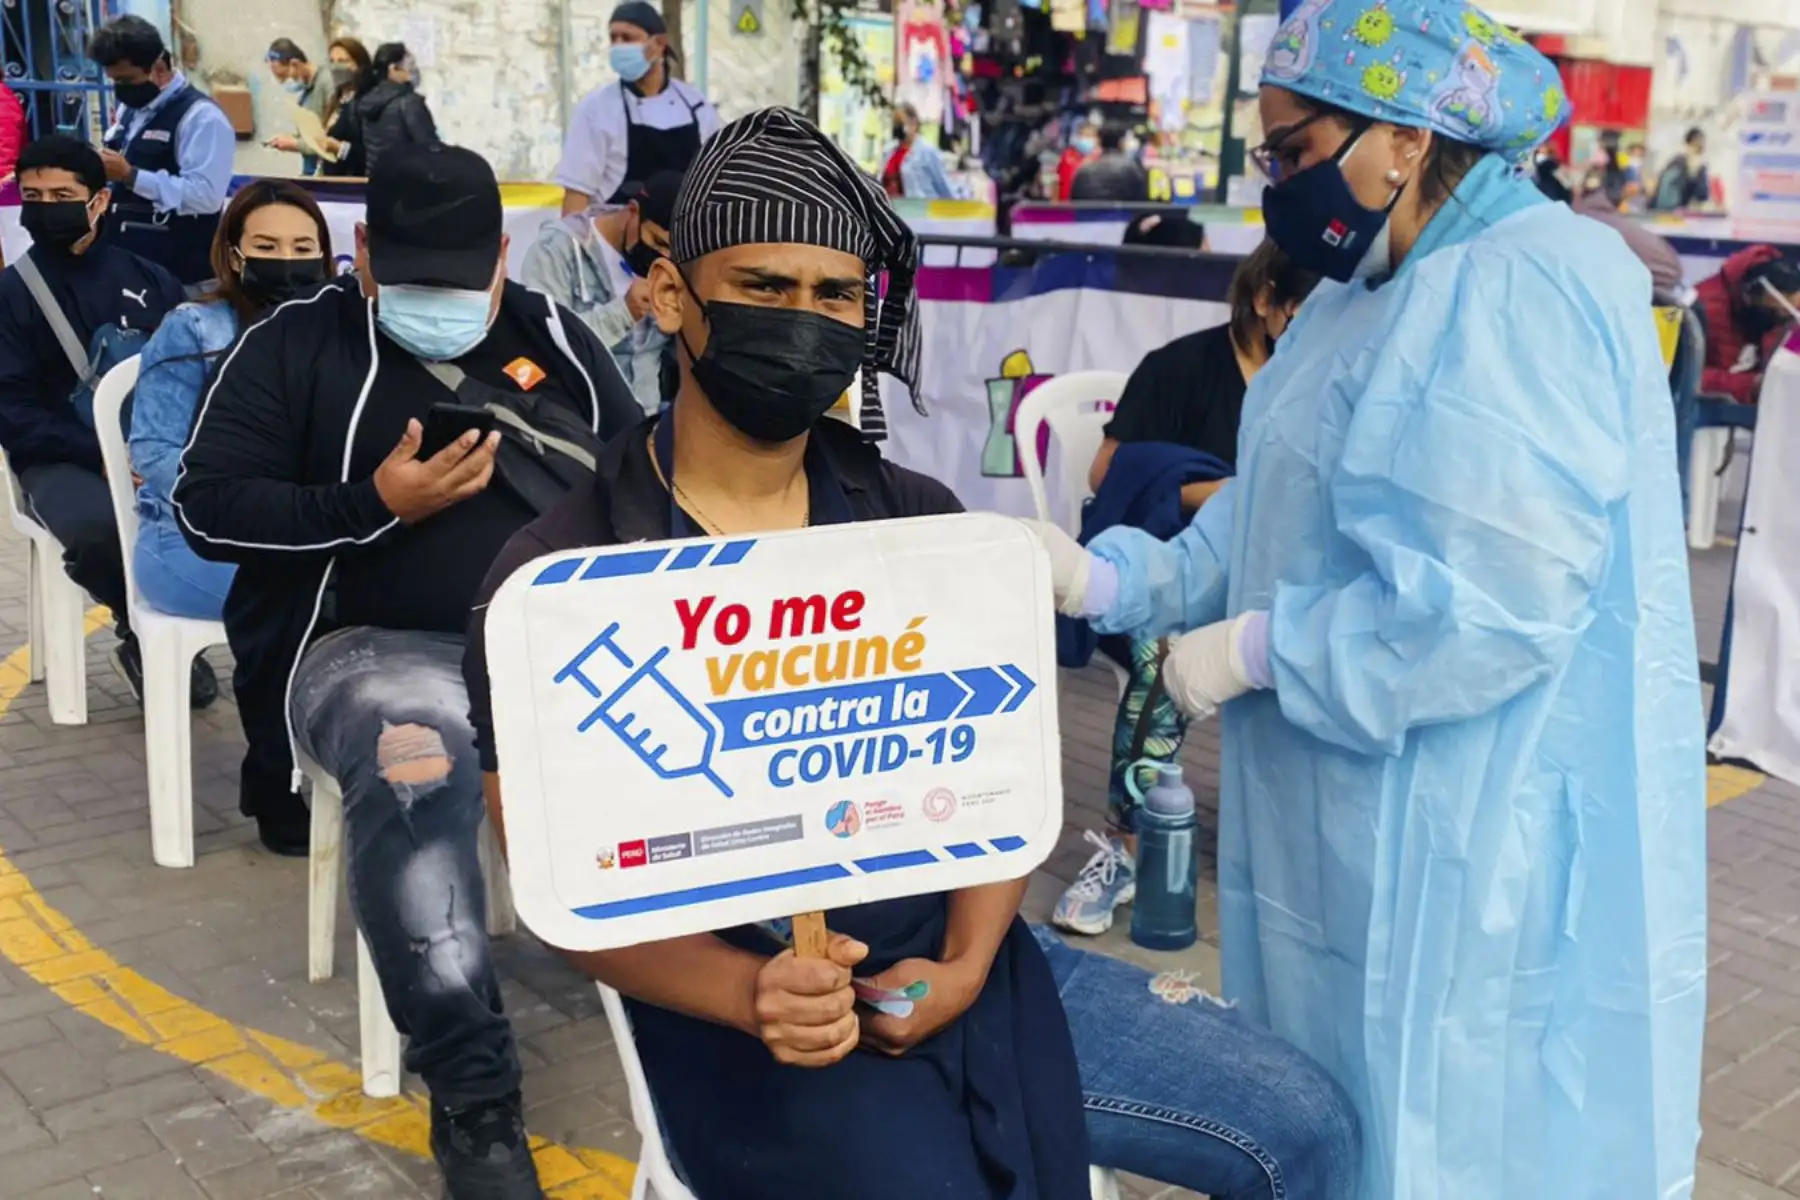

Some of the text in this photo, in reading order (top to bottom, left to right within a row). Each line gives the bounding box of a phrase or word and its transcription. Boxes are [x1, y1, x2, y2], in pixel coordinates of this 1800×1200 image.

[675, 590, 865, 650] Yo me
[705, 616, 927, 696] vacuné
[742, 683, 929, 741] contra la
[768, 723, 976, 787] COVID-19
